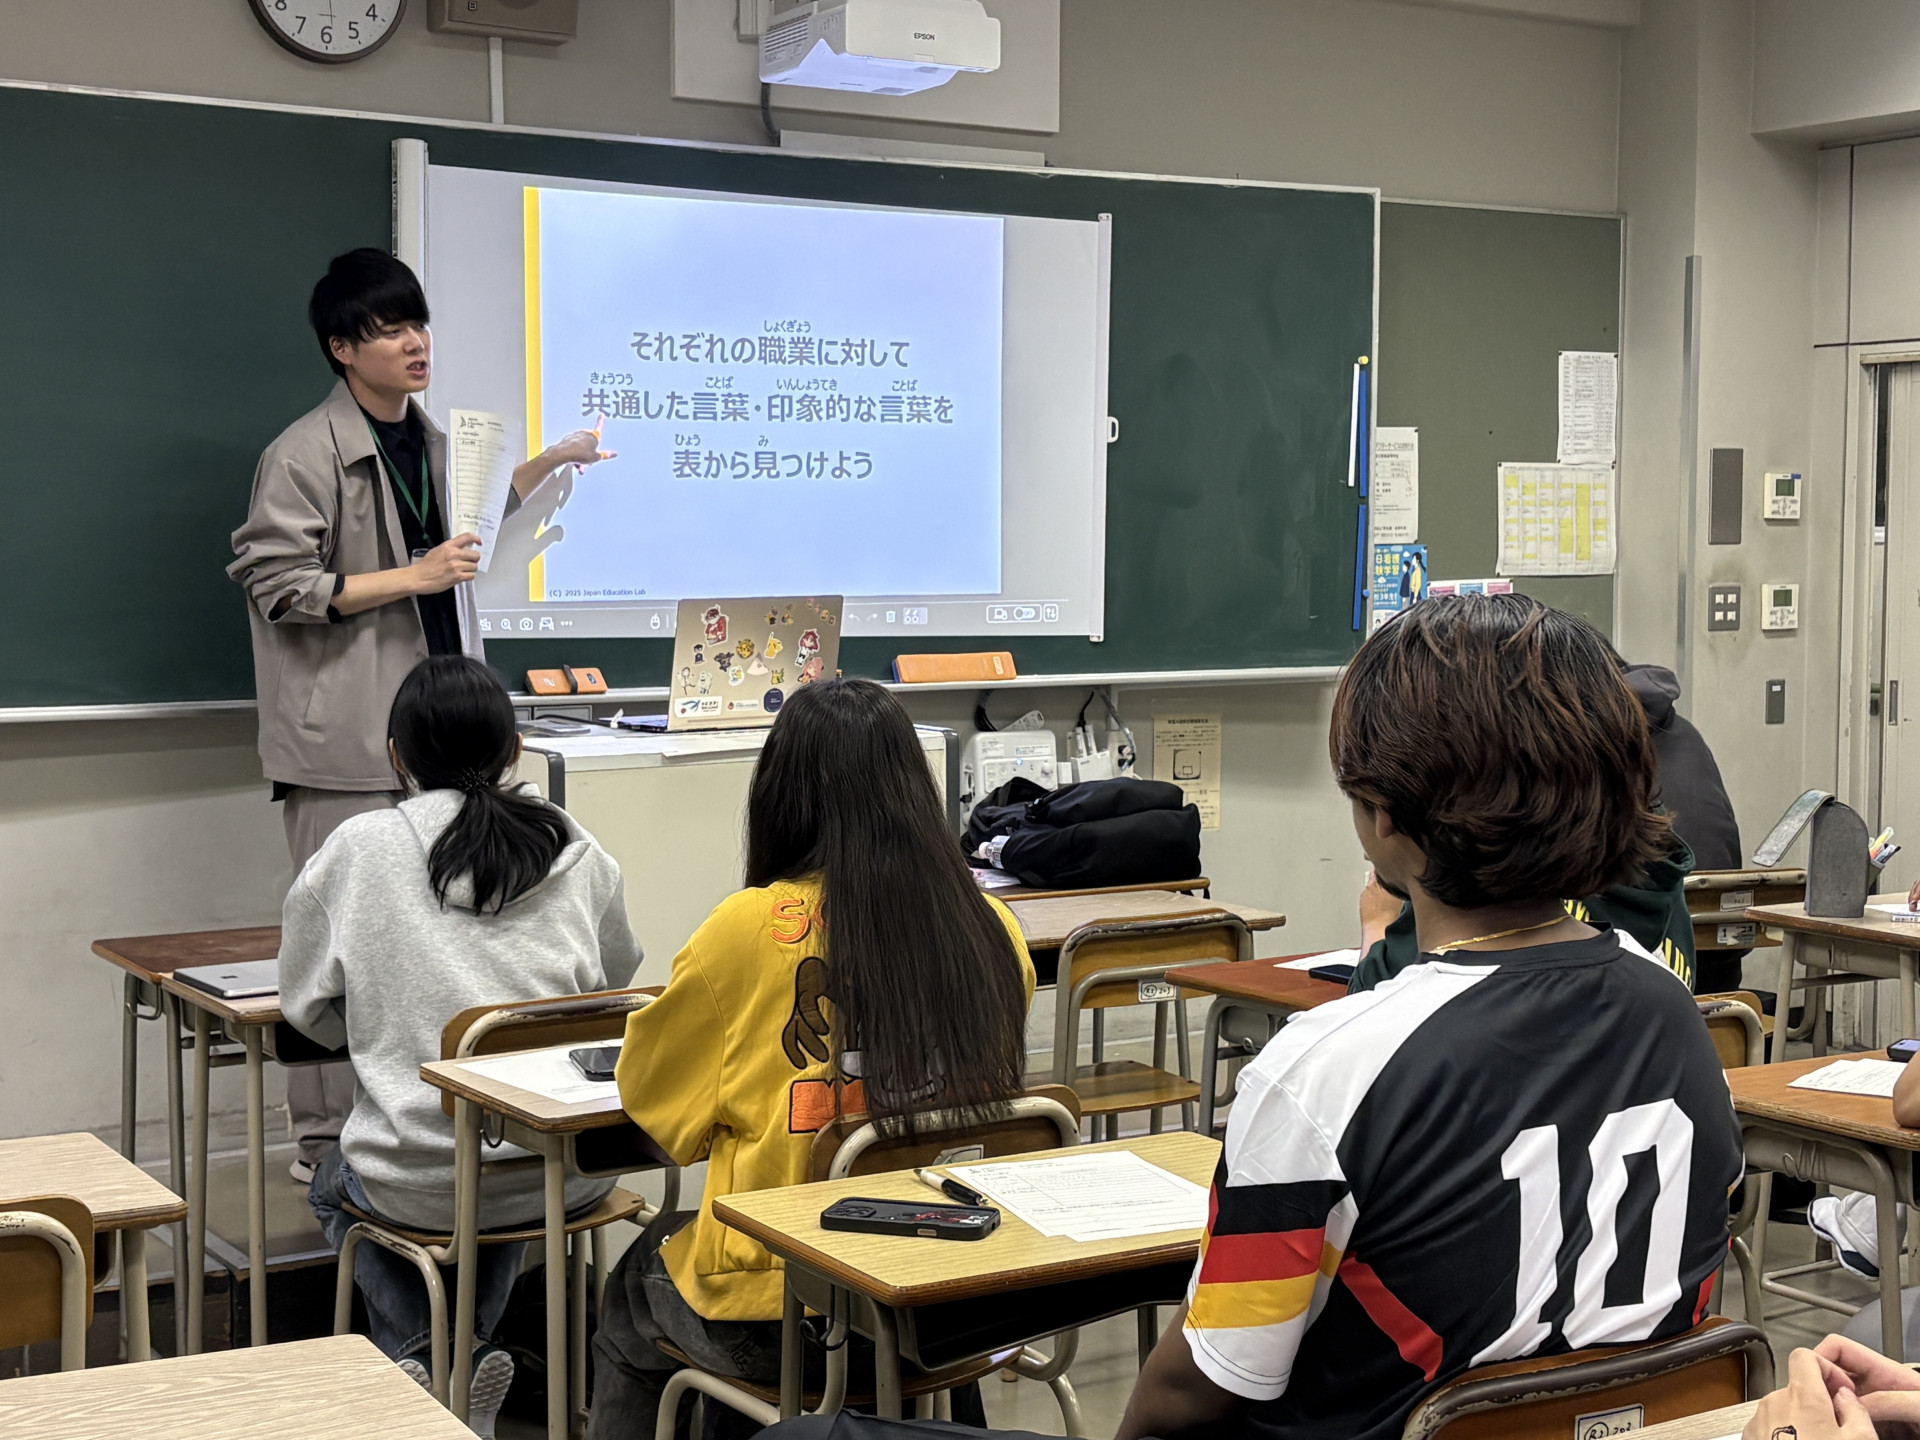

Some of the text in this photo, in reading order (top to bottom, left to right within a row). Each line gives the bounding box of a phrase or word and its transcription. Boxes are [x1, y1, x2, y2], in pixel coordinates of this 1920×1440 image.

[365, 3, 378, 21] 4
[295, 15, 306, 34] 7
[348, 21, 359, 39] 5
[320, 26, 333, 44] 6
[914, 32, 935, 41] EPSON
[764, 320, 811, 333] しょくぎょう
[631, 331, 910, 367] それぞれの職業に対して
[590, 372, 633, 385] きょうつう
[705, 376, 734, 389] ことば
[776, 378, 838, 391] いんしょうてき
[892, 379, 918, 392] ことば
[582, 388, 954, 423] 共通した言葉・印象的な言葉を
[675, 434, 701, 446] ひょう
[758, 435, 769, 447] み
[672, 449, 873, 480] 表から見つけよう
[583, 589, 601, 597] Japan
[634, 588, 646, 596] Lab
[1469, 1098, 1693, 1367] 10
